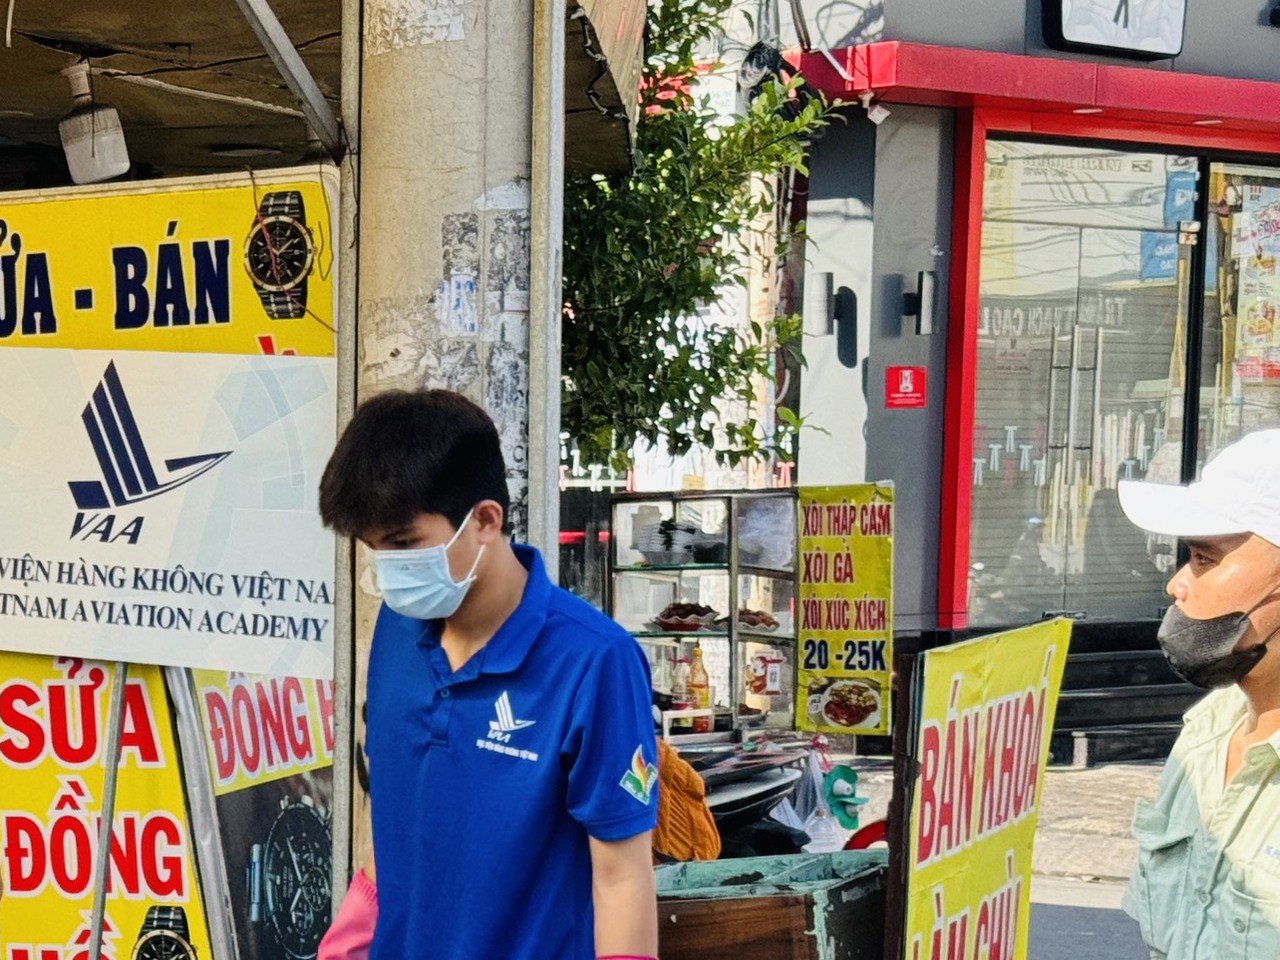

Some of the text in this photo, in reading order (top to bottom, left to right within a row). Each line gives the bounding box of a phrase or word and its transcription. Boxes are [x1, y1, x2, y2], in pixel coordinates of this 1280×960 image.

[112, 220, 230, 330] BÁN
[69, 512, 145, 545] VAA
[803, 499, 822, 536] XÔI
[56, 557, 126, 589] HÀNG
[132, 564, 224, 596] KHÔNG
[231, 570, 291, 607] VIỆT
[295, 579, 335, 605] NA
[802, 545, 854, 584] XÔI GÀ
[72, 599, 193, 632] AVIATION
[197, 610, 329, 642] ACADEMY
[802, 593, 886, 631] XÔI XÚC XÍCH
[803, 640, 828, 670] 20
[917, 679, 979, 864] BÁN
[5, 780, 184, 897] ĐỒNG
